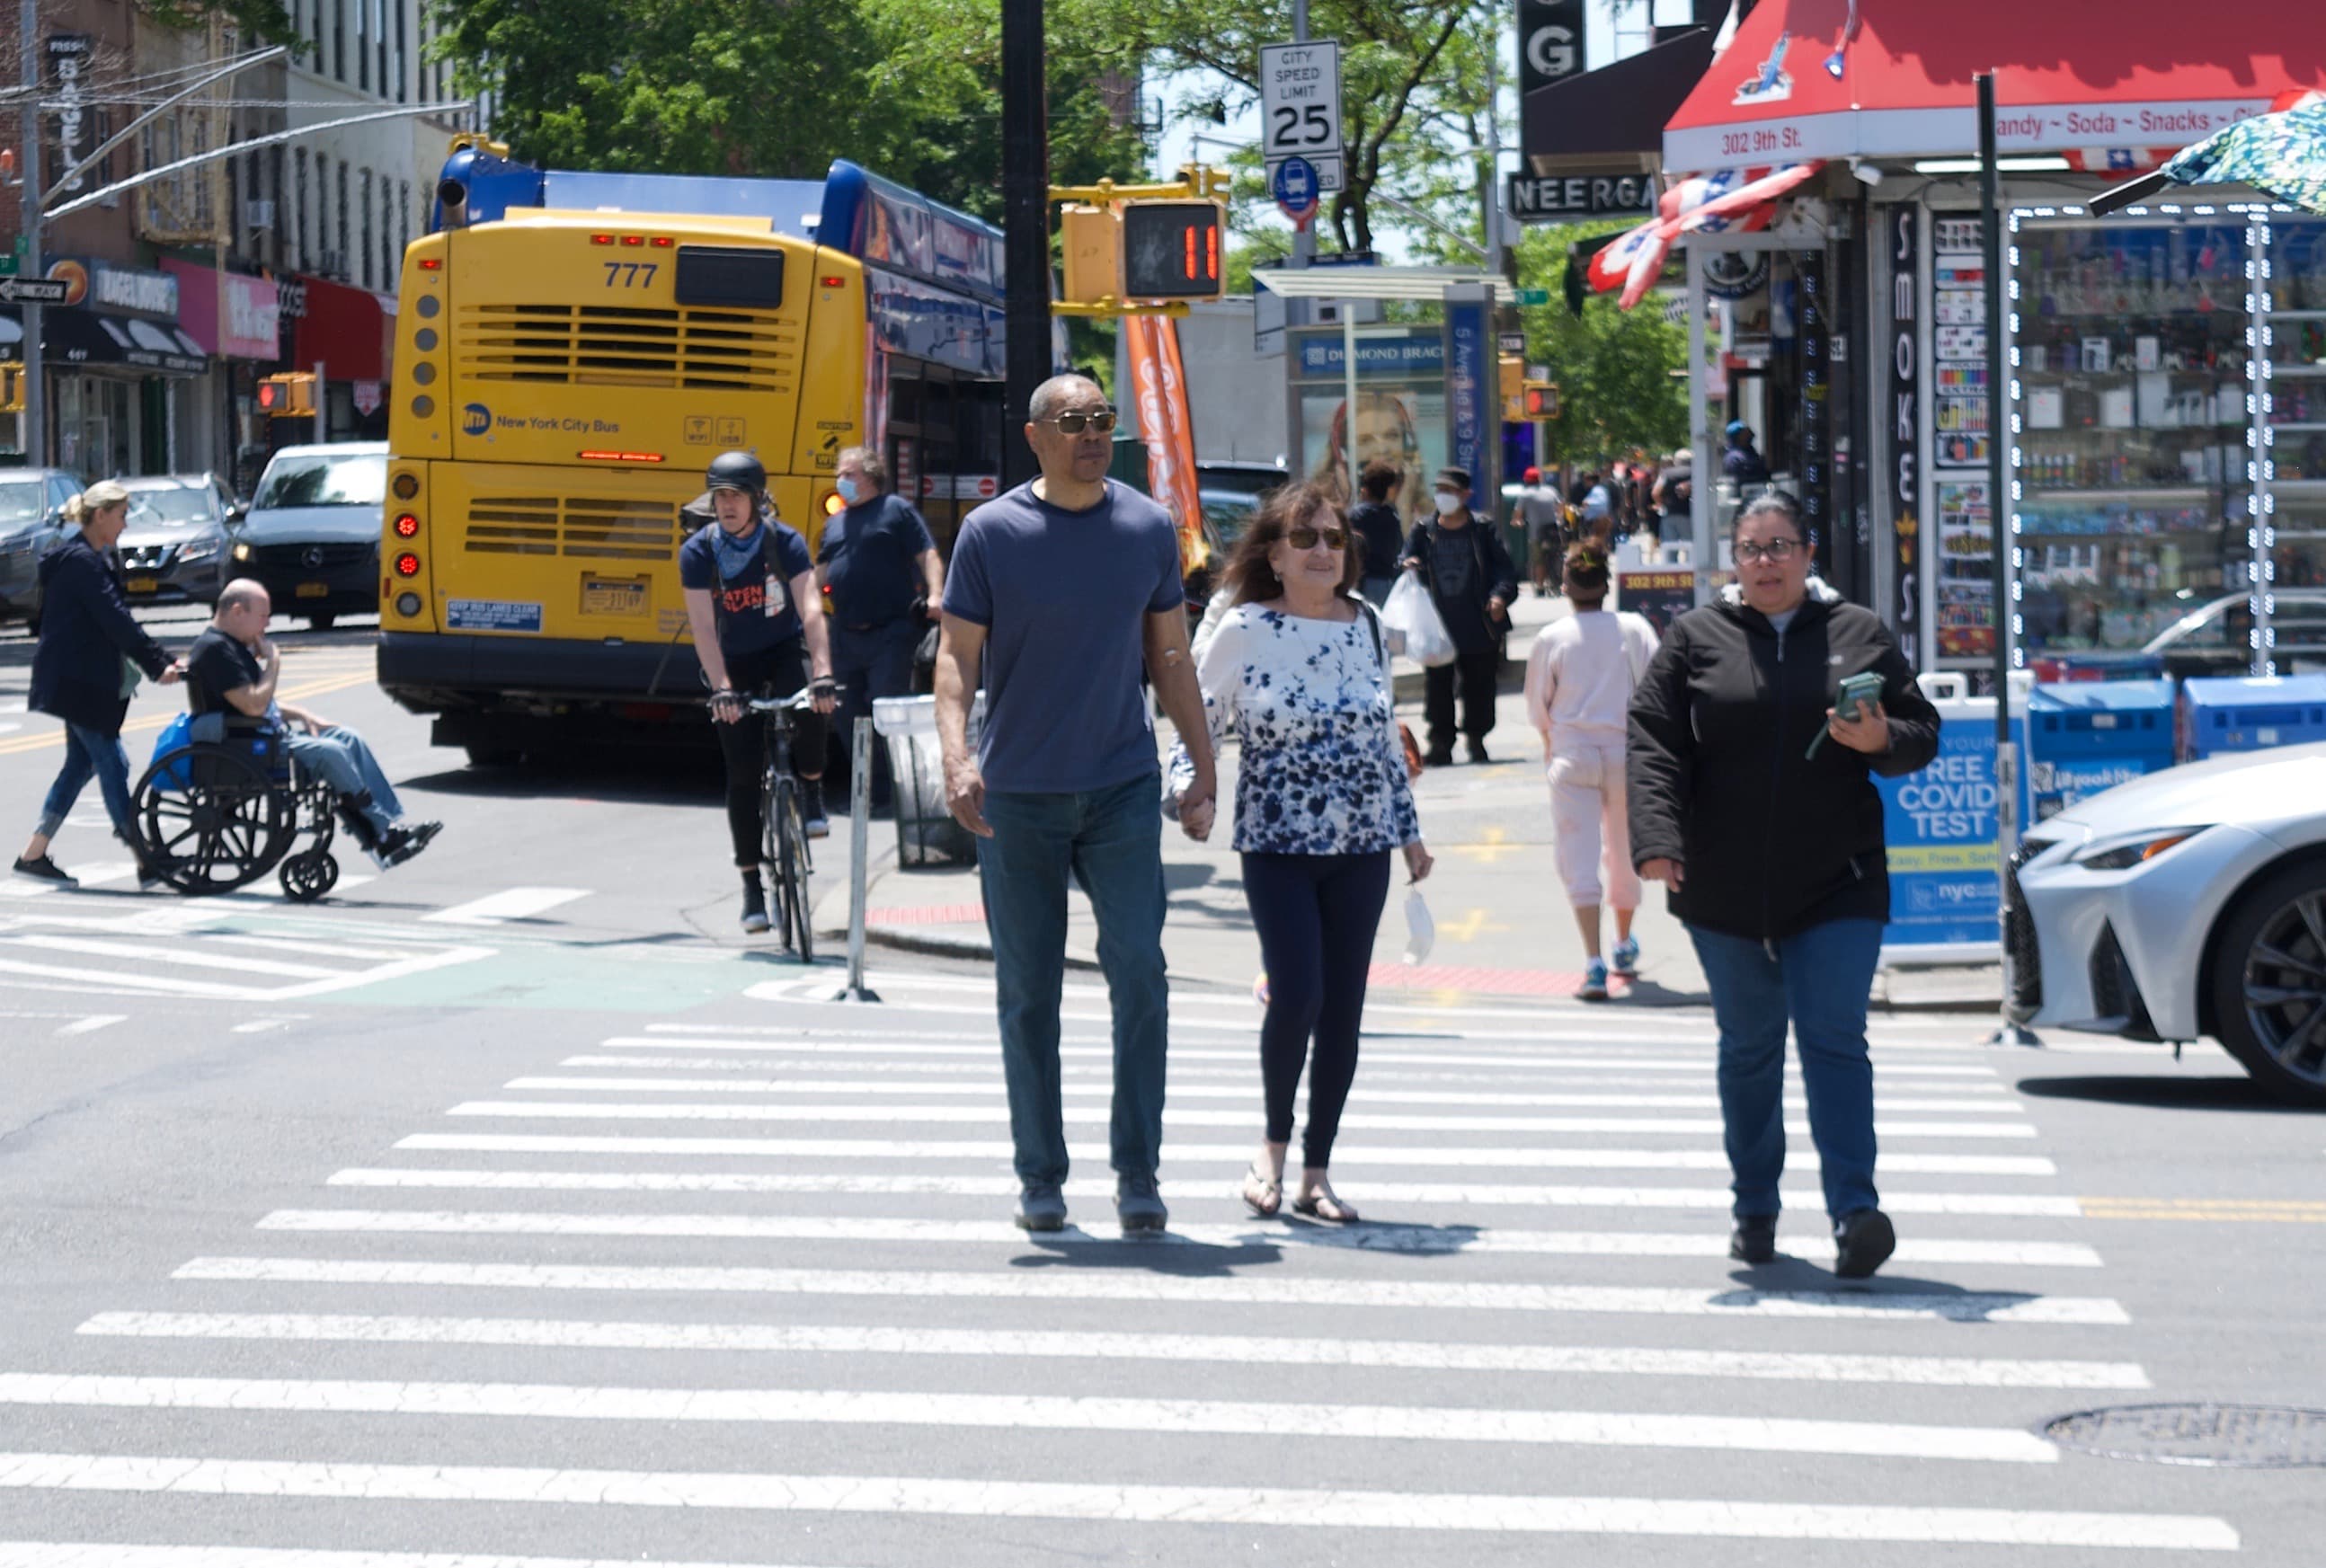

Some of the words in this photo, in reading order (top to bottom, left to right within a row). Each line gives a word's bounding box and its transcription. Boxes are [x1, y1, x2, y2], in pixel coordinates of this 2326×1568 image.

[1281, 51, 1312, 65] CITY
[1275, 68, 1320, 83] SPEED
[1281, 85, 1317, 100] LIMIT
[58, 58, 83, 190] BAGELS
[1273, 104, 1329, 146] 25
[1996, 114, 2042, 140] andy
[2066, 111, 2116, 134] Soda
[2139, 109, 2210, 132] Snacks
[1722, 132, 1748, 155] 302
[1753, 129, 1776, 151] 9th
[1782, 127, 1801, 147] St.
[1185, 225, 1217, 280] 11
[604, 262, 658, 288] 777
[34, 286, 58, 297] WAY
[1456, 328, 1470, 338] 5
[1328, 347, 1397, 361] DIMOND
[1456, 343, 1471, 403] Avenue
[496, 416, 526, 429] New
[529, 418, 557, 430] York
[562, 419, 590, 433] City
[593, 421, 619, 433] Bus
[1458, 412, 1473, 422] &
[1459, 430, 1473, 439] 9
[1625, 576, 1651, 589] 302
[1653, 575, 1675, 589] 9th
[1943, 736, 1995, 752] YOUR
[1898, 783, 1997, 811] COVID
[1910, 811, 1987, 838] TEST
[1939, 883, 1975, 902] nyc
